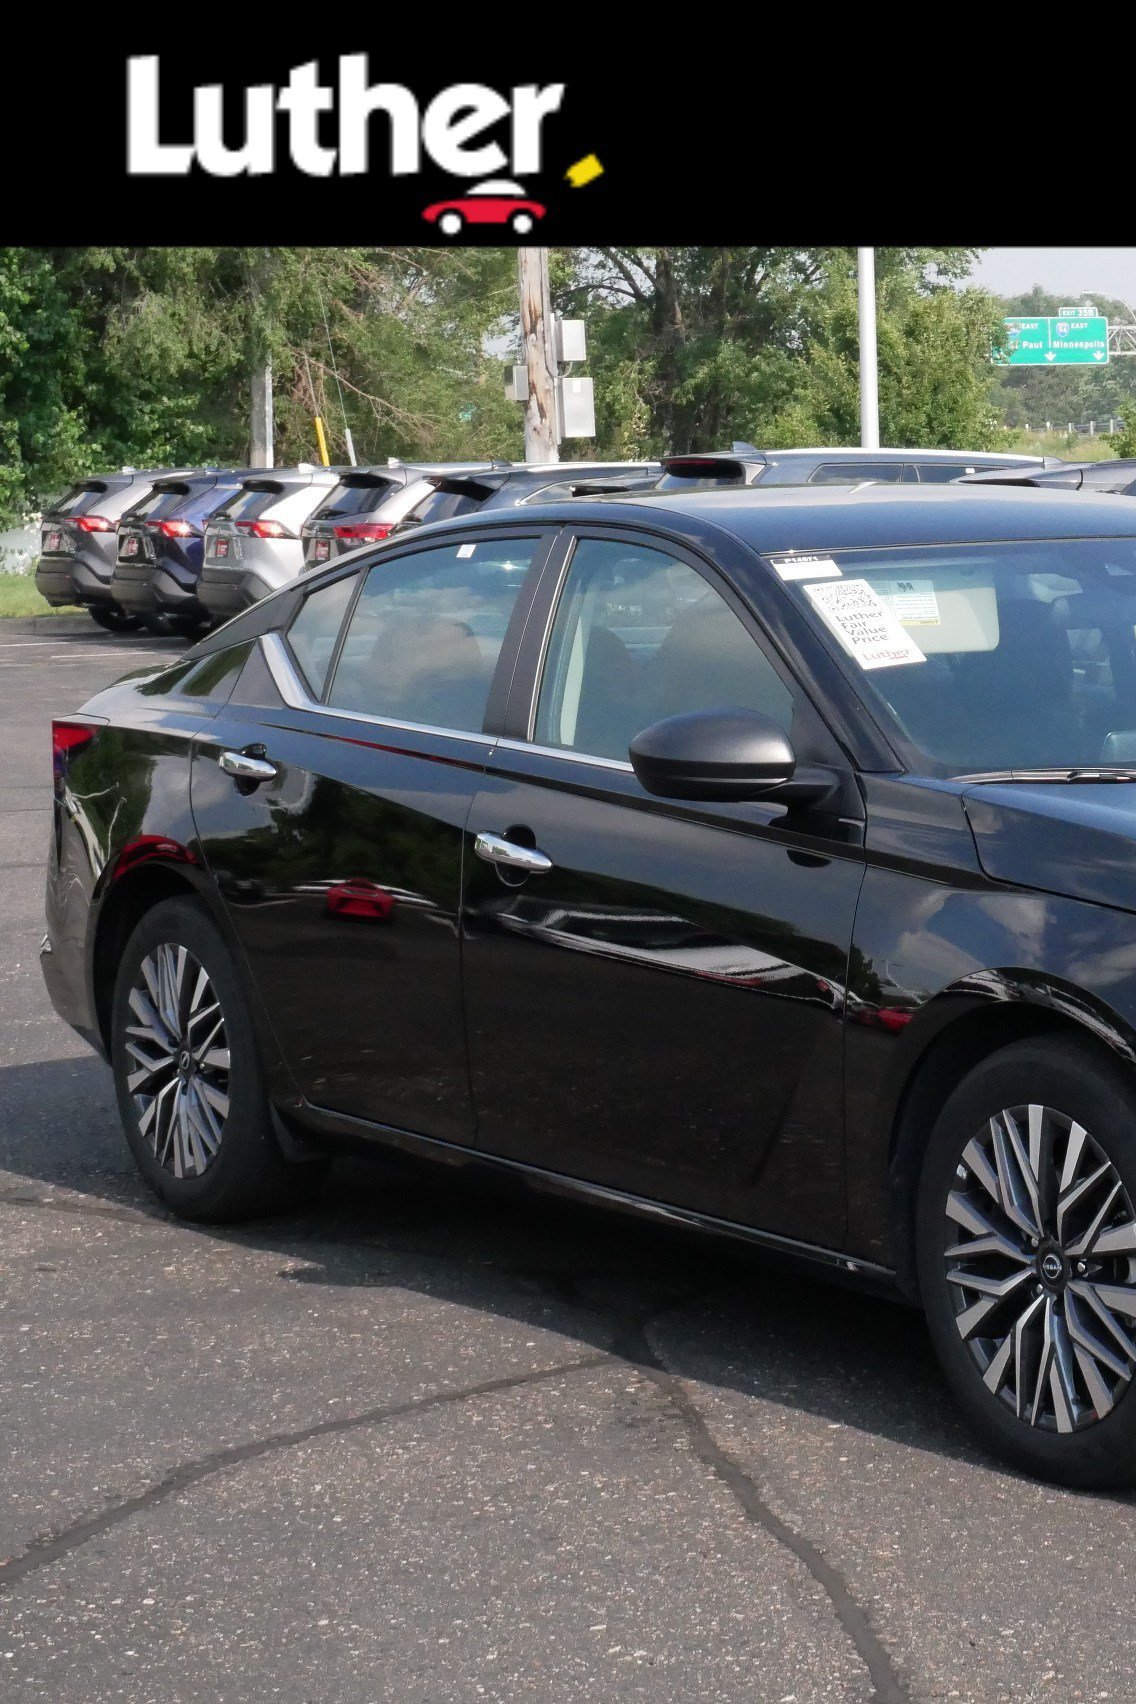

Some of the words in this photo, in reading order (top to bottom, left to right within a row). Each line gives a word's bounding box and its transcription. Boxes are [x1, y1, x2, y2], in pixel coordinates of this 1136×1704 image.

[1022, 322, 1039, 330] EAST
[1022, 340, 1043, 349] Paul
[1053, 340, 1105, 350] Minneapolis
[835, 611, 883, 622] Luther
[840, 621, 867, 630] Fair
[846, 626, 888, 636] Value
[851, 634, 889, 645] Price
[862, 648, 910, 660] Luther
